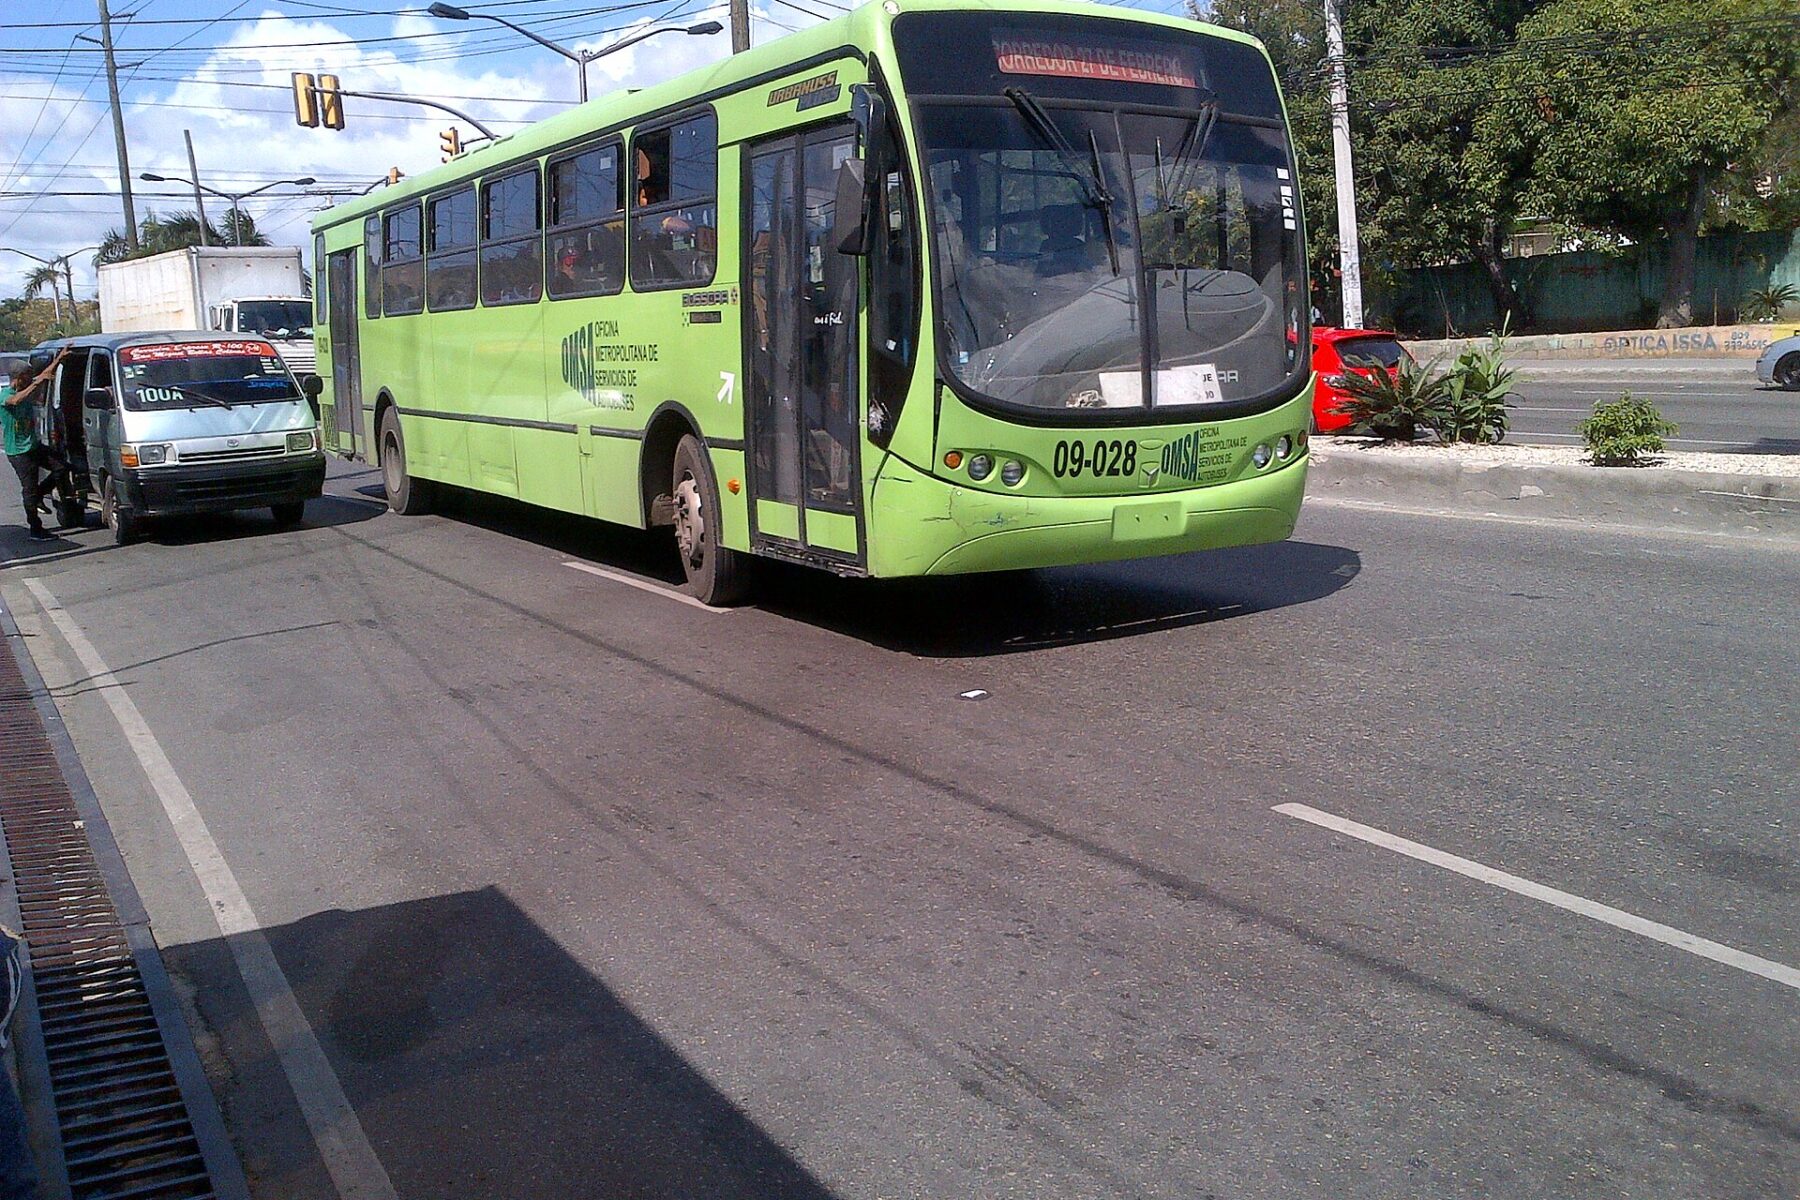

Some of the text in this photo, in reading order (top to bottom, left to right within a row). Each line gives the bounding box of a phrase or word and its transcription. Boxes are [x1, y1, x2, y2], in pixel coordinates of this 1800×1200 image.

[768, 71, 837, 106] URBANUSS
[595, 320, 619, 337] OFICINA
[1673, 332, 1717, 351] ISSA
[595, 344, 659, 362] METROPOLITANA DE
[562, 322, 597, 407] OMSA
[595, 369, 637, 387] SERVICIOS DE
[1199, 426, 1220, 439] OFICINA
[1199, 436, 1248, 453] METROPOLITANA DE
[1054, 440, 1137, 477] 09-028
[1161, 430, 1200, 481] OMSA
[1199, 453, 1232, 468] SERVICIOS DE
